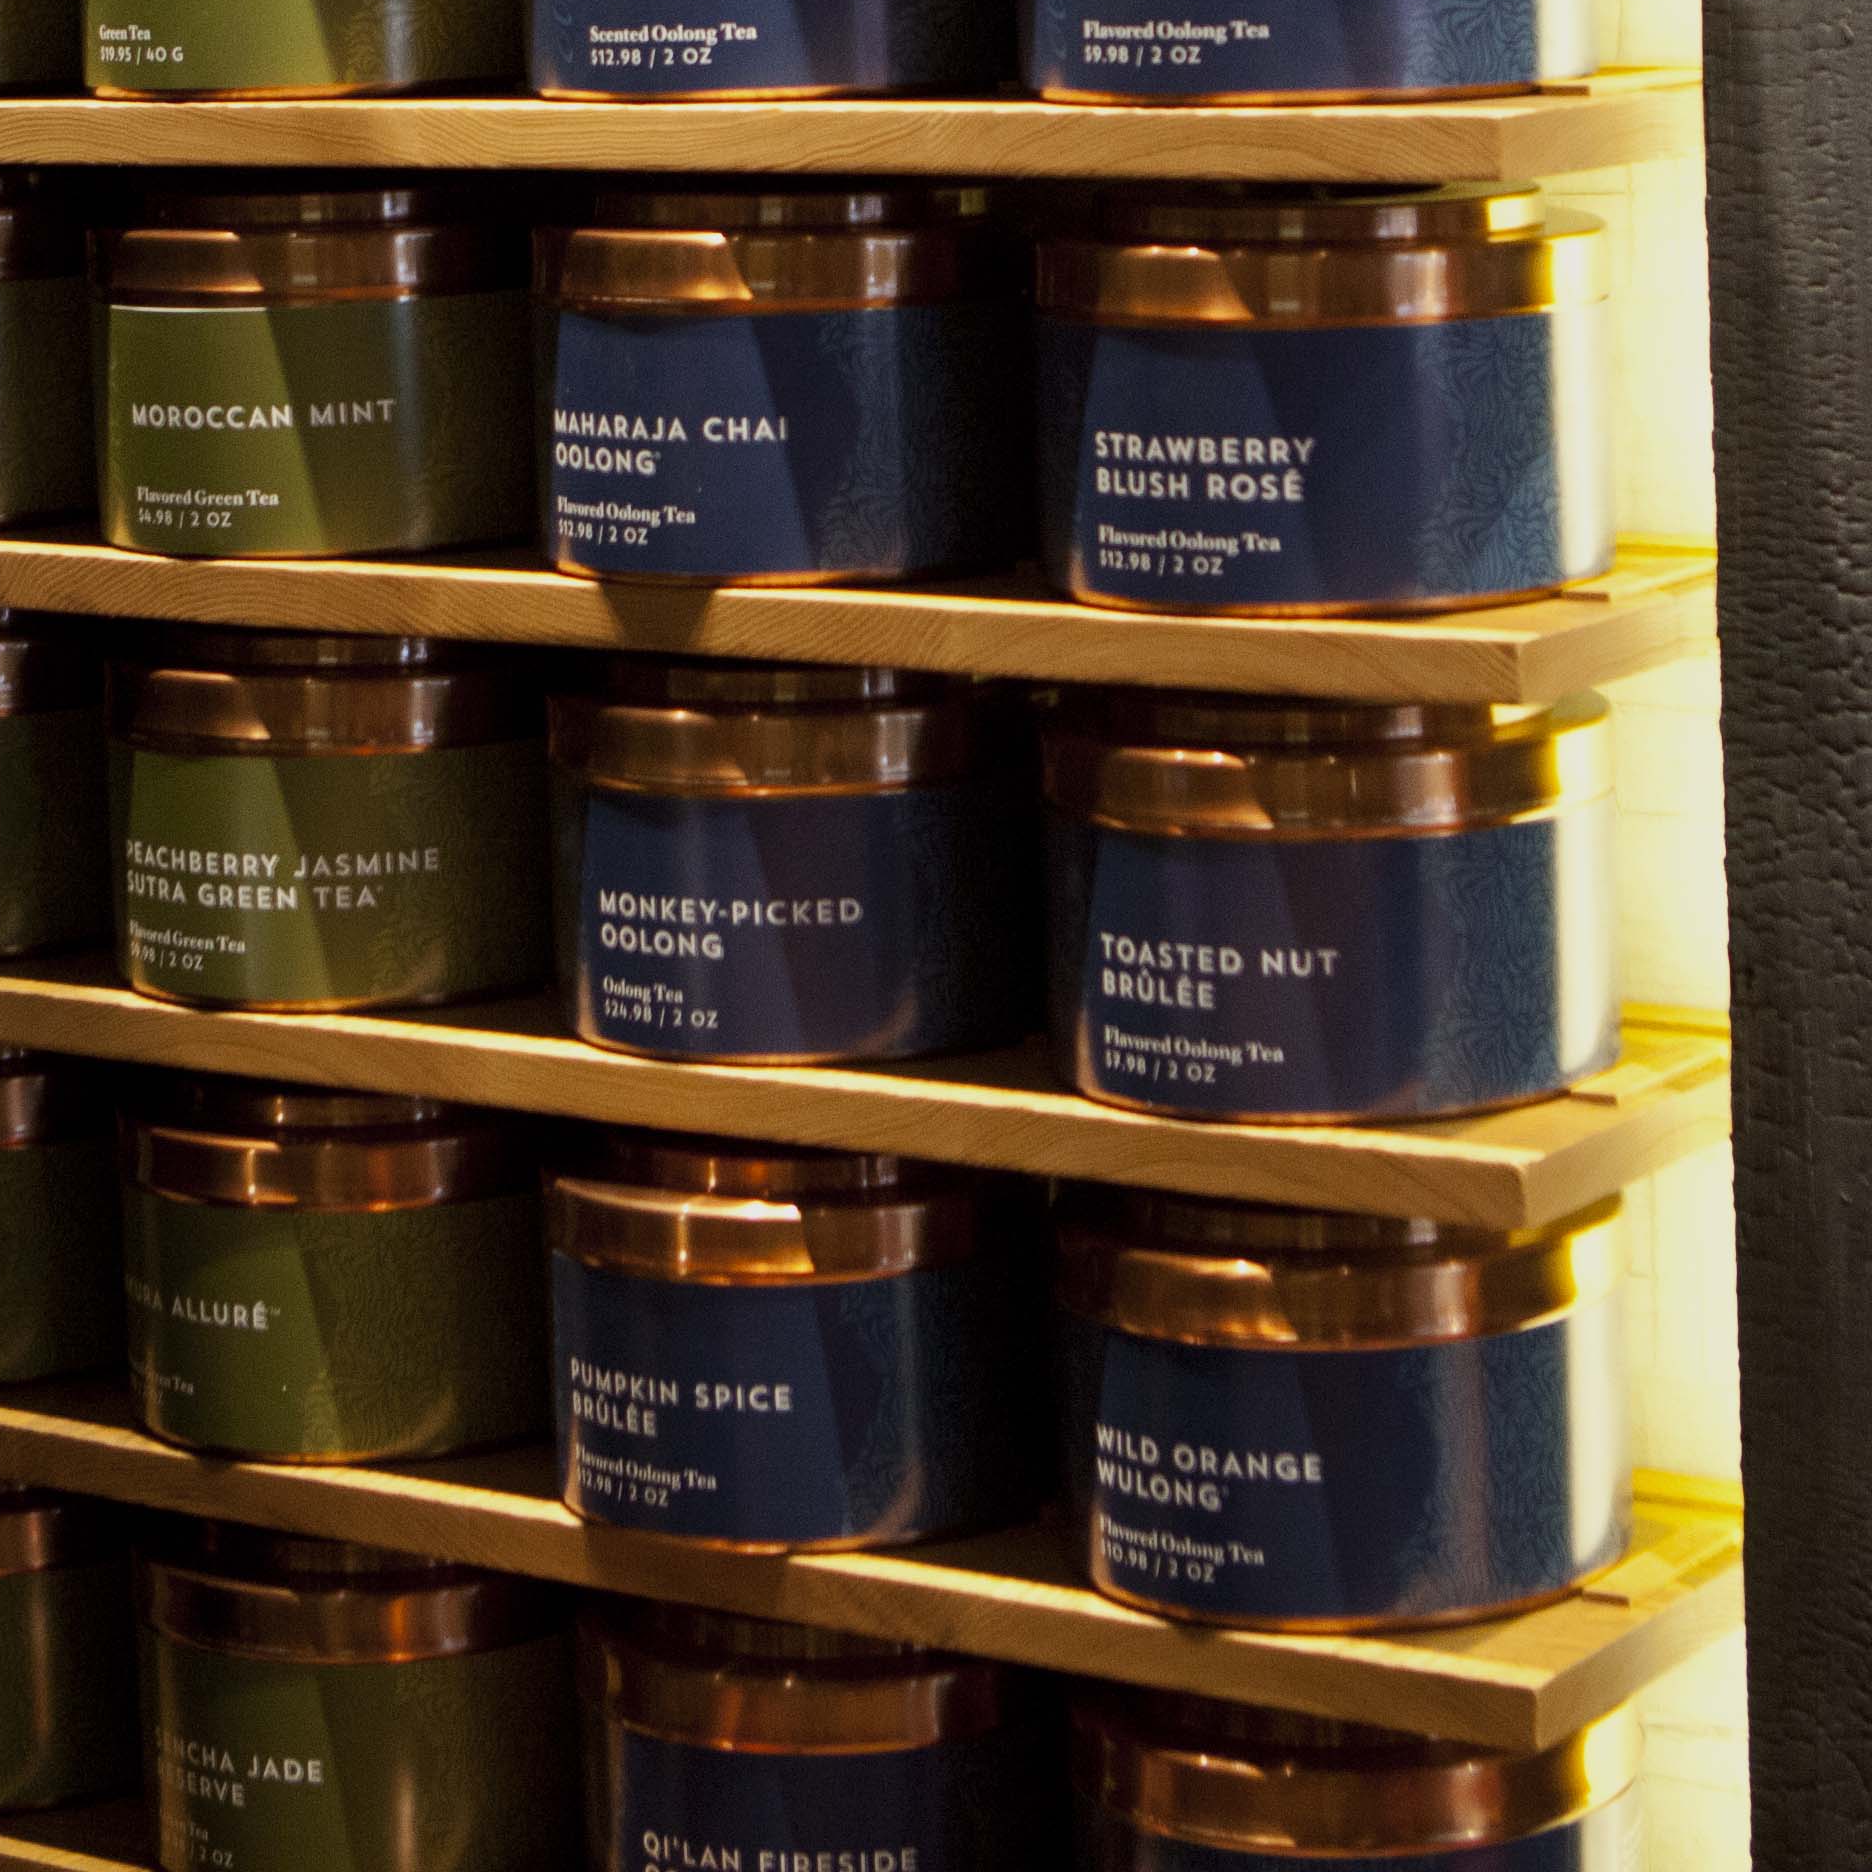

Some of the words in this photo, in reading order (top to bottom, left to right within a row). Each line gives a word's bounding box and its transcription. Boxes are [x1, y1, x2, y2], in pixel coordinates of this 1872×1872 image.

[100, 25, 128, 42] Green
[128, 24, 151, 40] Tea
[588, 25, 650, 43] Scented
[652, 24, 719, 46] Oolong
[720, 22, 758, 41] Tea
[1082, 19, 1155, 40] Flavored
[1156, 19, 1229, 45] Oolong
[1228, 19, 1270, 40] Tea
[101, 46, 132, 63] $19.95
[146, 46, 166, 62] 40
[171, 46, 184, 62] G
[590, 48, 641, 68] $12.98
[664, 48, 674, 65] 2
[682, 48, 712, 65] OZ
[132, 402, 294, 430] MOROCCAN
[309, 398, 397, 428] MINT
[553, 409, 687, 441] MAHARAJA
[703, 416, 788, 441] CHAI
[1094, 431, 1317, 466] STRAWBERRY
[136, 486, 192, 506] Flavored
[194, 489, 244, 507] Green
[246, 488, 280, 508] Tea
[1096, 466, 1190, 500] BLUSH
[190, 510, 200, 528] 2
[206, 510, 232, 528] OZ
[556, 496, 604, 519] Flavored
[606, 502, 660, 528] Oolong
[664, 504, 696, 525] Tea
[1098, 525, 1166, 548] Flavored
[1168, 530, 1240, 558] Oolong
[1240, 532, 1282, 554] Tea
[127, 839, 280, 879] PEACHBERRY
[294, 848, 440, 878] JASMINE
[128, 870, 186, 904] SUTRA
[197, 882, 298, 910] GREEN
[598, 888, 864, 926] MONKEY-PICKED
[172, 929, 214, 950] Green
[216, 935, 246, 955] Tea
[600, 922, 724, 960] OOLONG
[1100, 931, 1244, 976] TOASTED
[1260, 949, 1340, 978] NUT
[602, 975, 651, 1003] Oolong
[653, 983, 684, 1004] Tea
[604, 999, 652, 1024] $24.98
[672, 1010, 682, 1028] 2
[690, 1010, 719, 1030] OZ
[1104, 1025, 1172, 1055] Flavored
[1173, 1036, 1242, 1066] Oolong
[1244, 1040, 1284, 1062] Tea
[571, 1356, 679, 1406] PUMPKIN
[693, 1382, 794, 1412] SPICE
[1096, 1422, 1160, 1466] WILD
[1172, 1441, 1324, 1483] ORANGE
[625, 1457, 681, 1492] Oolong
[683, 1465, 718, 1492] Tea
[1160, 1530, 1224, 1568] Oolong
[1228, 1540, 1264, 1567] Tea
[247, 1752, 323, 1786] JADE
[760, 1847, 919, 1872] FIRESIDE
